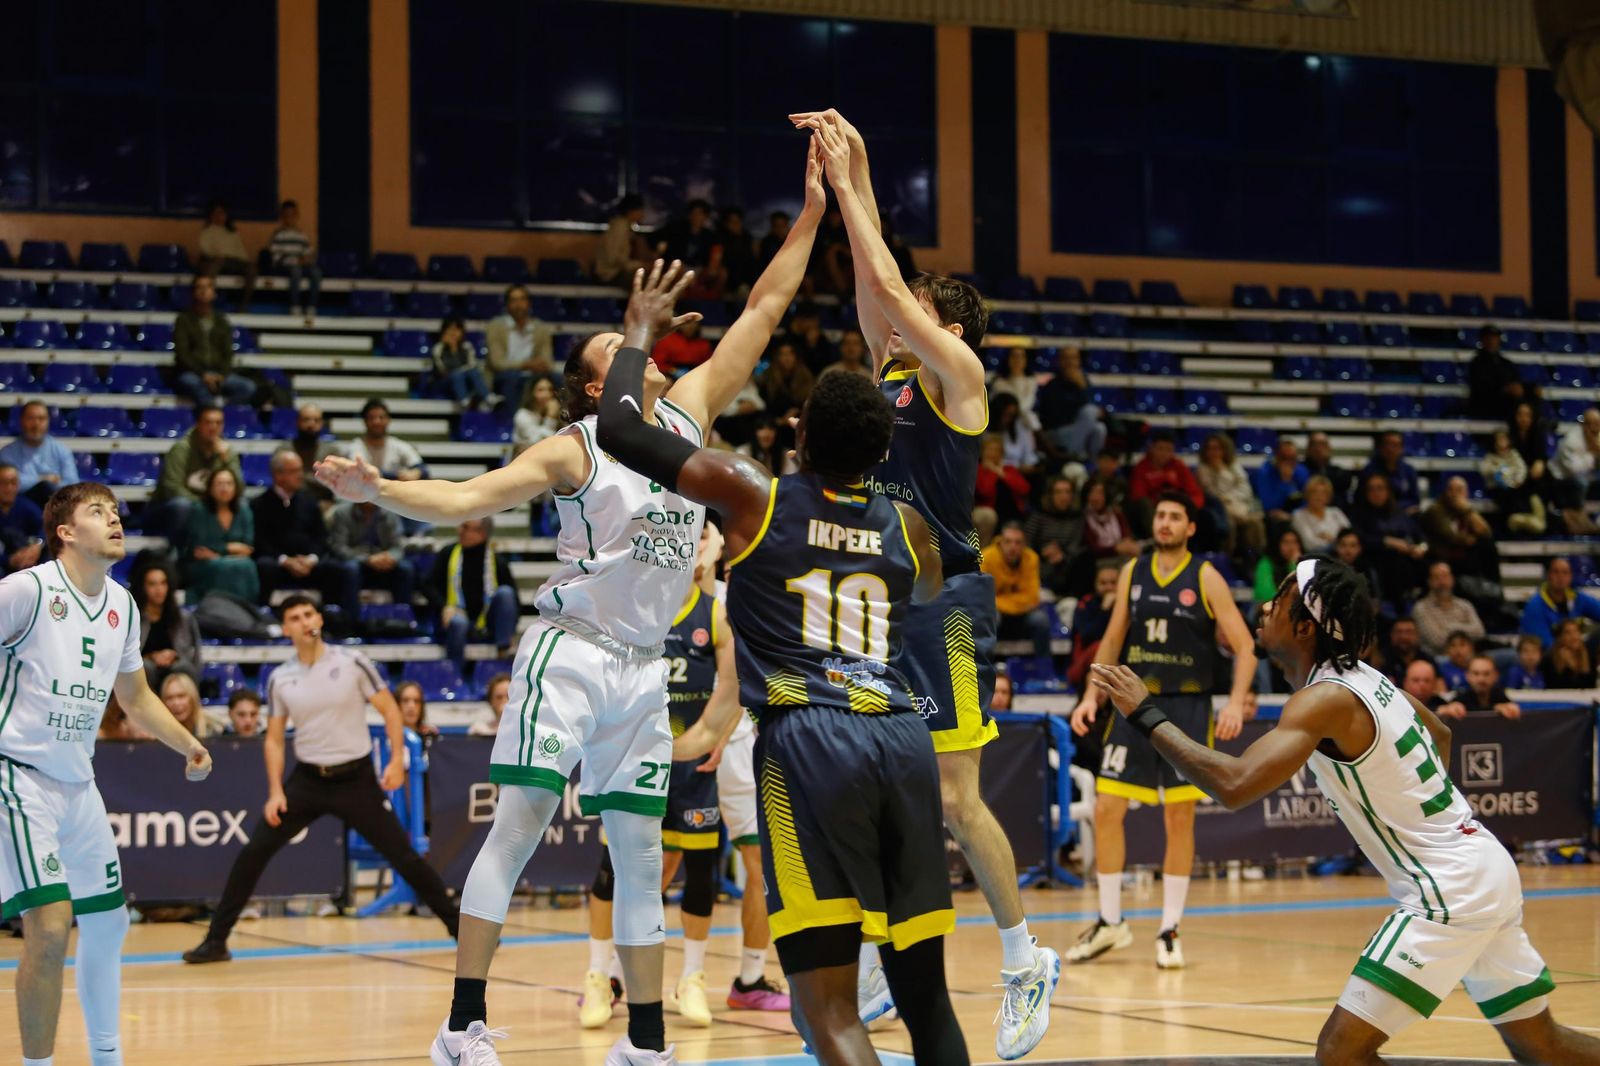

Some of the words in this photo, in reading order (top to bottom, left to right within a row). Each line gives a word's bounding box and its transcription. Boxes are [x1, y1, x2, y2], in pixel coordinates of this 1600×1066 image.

[632, 505, 695, 525] obe
[807, 519, 882, 556] IKPEZE
[785, 568, 892, 663] 10
[1144, 618, 1168, 643] 14
[81, 636, 95, 669] 5
[52, 679, 107, 703] Lobe
[1102, 743, 1129, 774] 14
[635, 761, 671, 791] 27
[105, 861, 120, 888] 5
